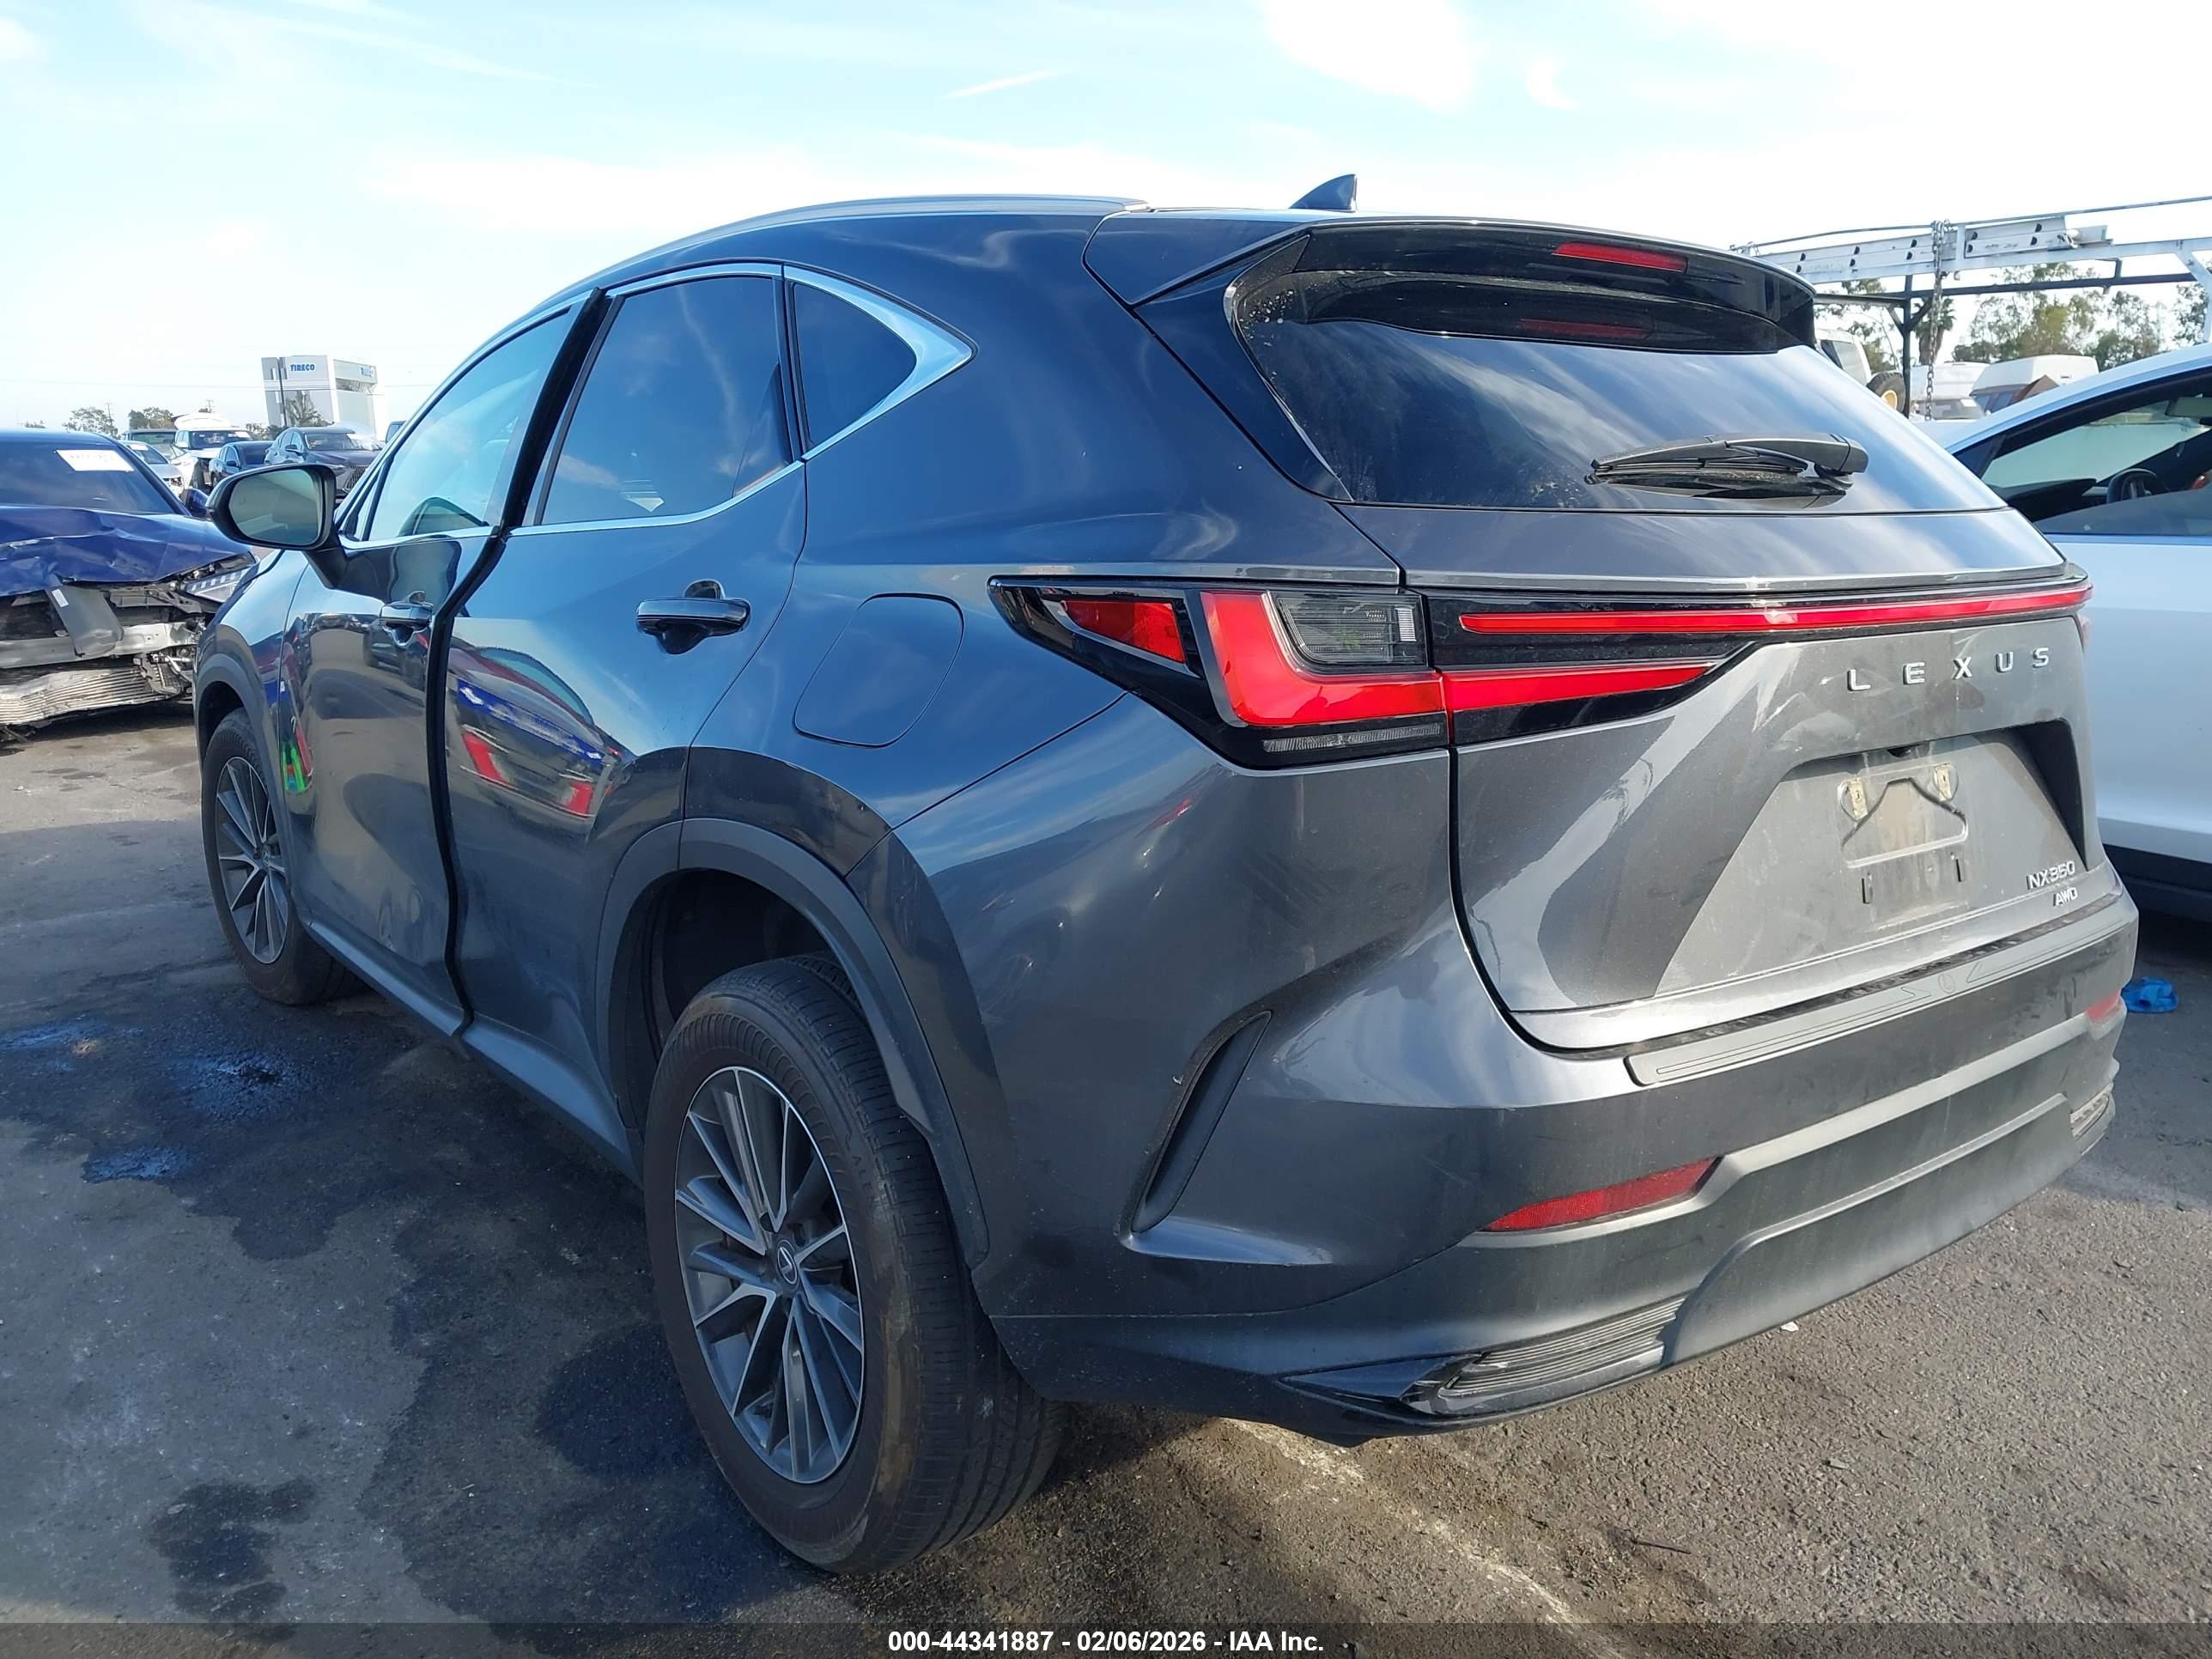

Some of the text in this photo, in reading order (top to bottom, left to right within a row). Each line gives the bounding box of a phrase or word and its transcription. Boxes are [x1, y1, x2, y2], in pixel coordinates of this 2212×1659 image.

[289, 363, 315, 372] TIRECO
[1847, 647, 2049, 692] LEXUS
[2027, 860, 2075, 890] NX350
[2053, 887, 2078, 907] AWD
